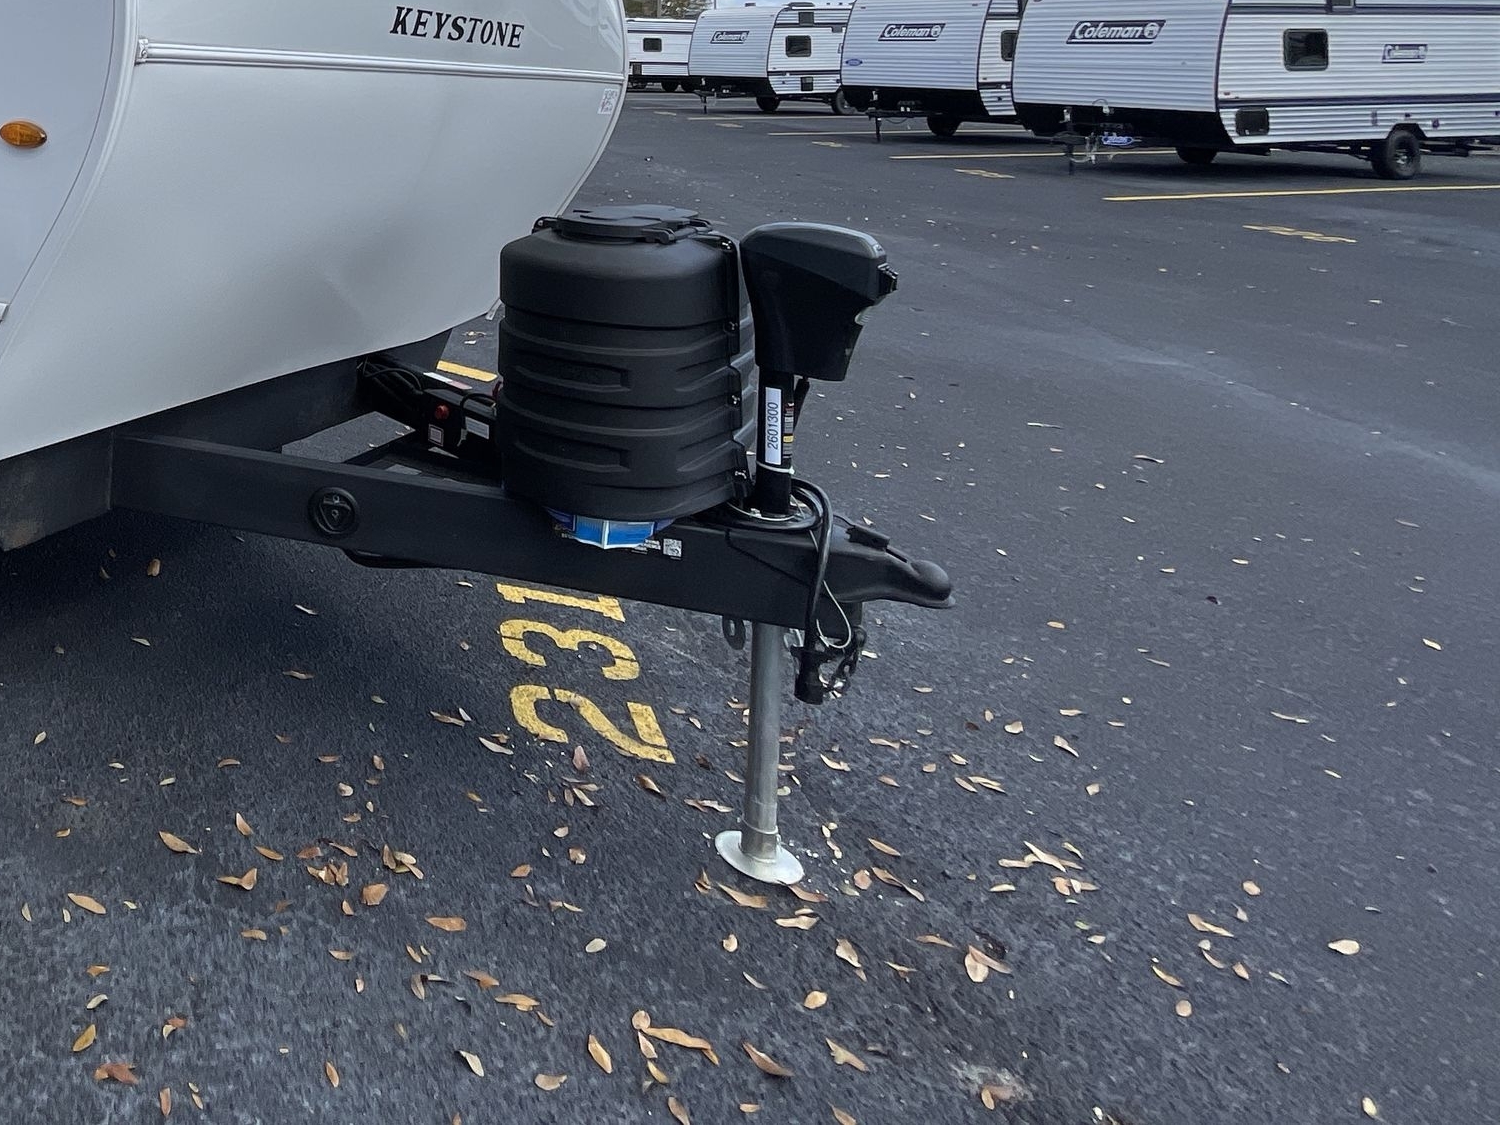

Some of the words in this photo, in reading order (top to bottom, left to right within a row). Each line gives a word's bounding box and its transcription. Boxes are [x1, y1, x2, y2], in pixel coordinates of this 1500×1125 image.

[389, 6, 525, 48] KEYSTONE
[884, 25, 930, 37] Coleman
[1075, 22, 1143, 39] Coleman
[767, 402, 779, 450] 2601300
[496, 583, 676, 764] 231
